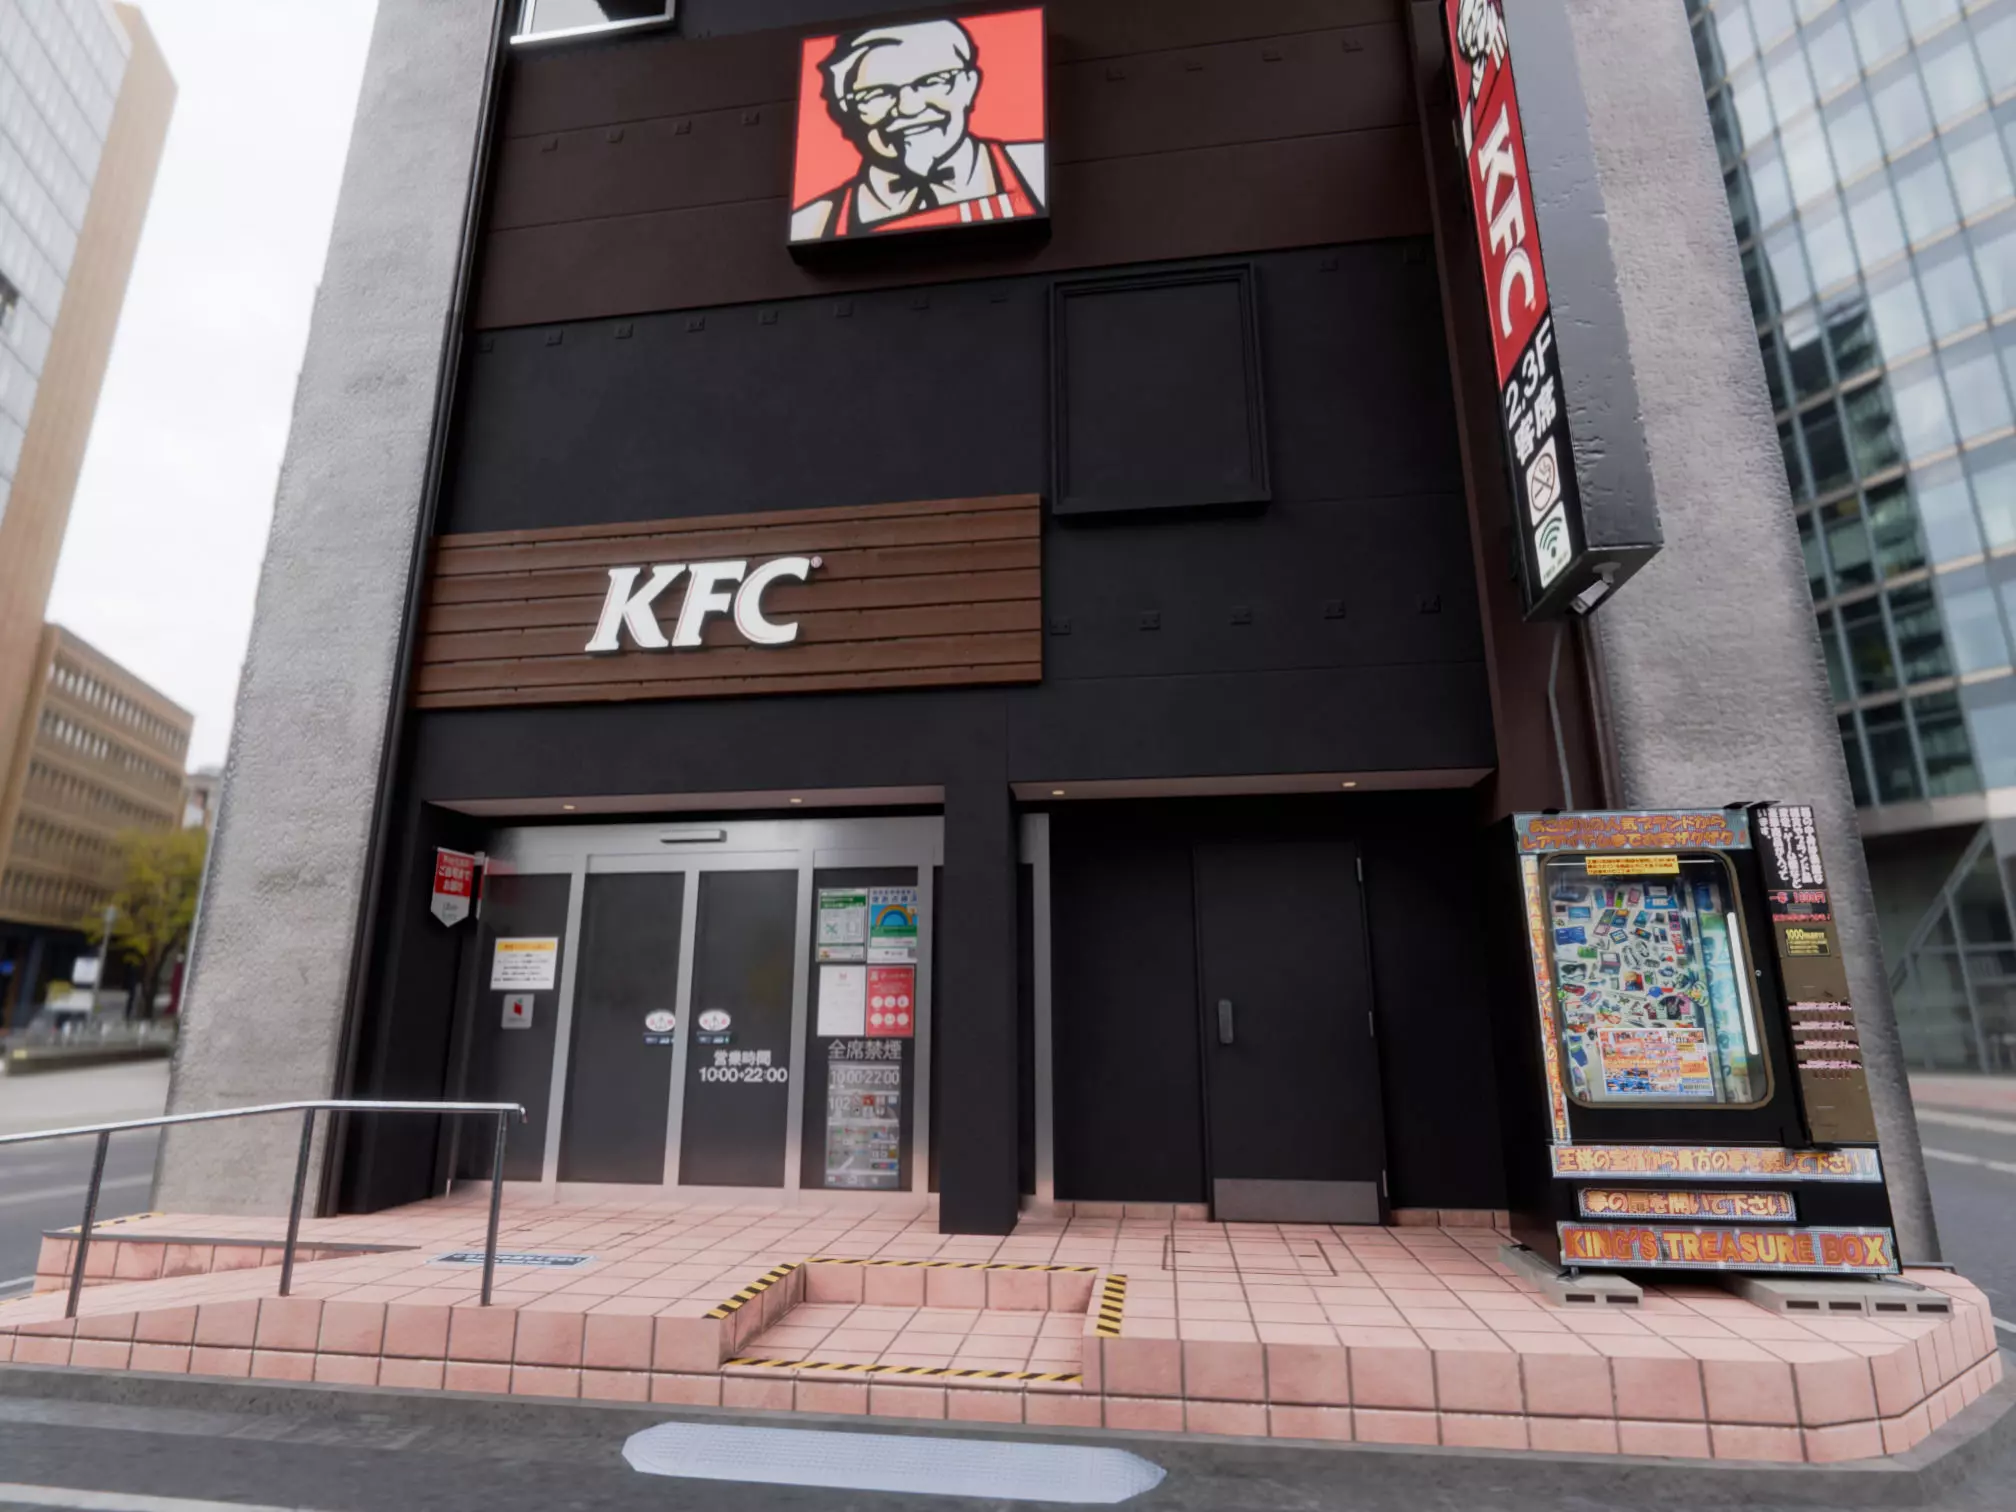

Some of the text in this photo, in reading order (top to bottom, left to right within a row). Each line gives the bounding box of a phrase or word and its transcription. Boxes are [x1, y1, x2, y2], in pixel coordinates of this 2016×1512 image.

[1478, 101, 1535, 338] KFC
[585, 557, 811, 651] KFC
[714, 1049, 772, 1067] 営業時間
[827, 1039, 903, 1060] 全席禁煙
[1562, 1228, 1889, 1266] KING'S TREASURE BOX
